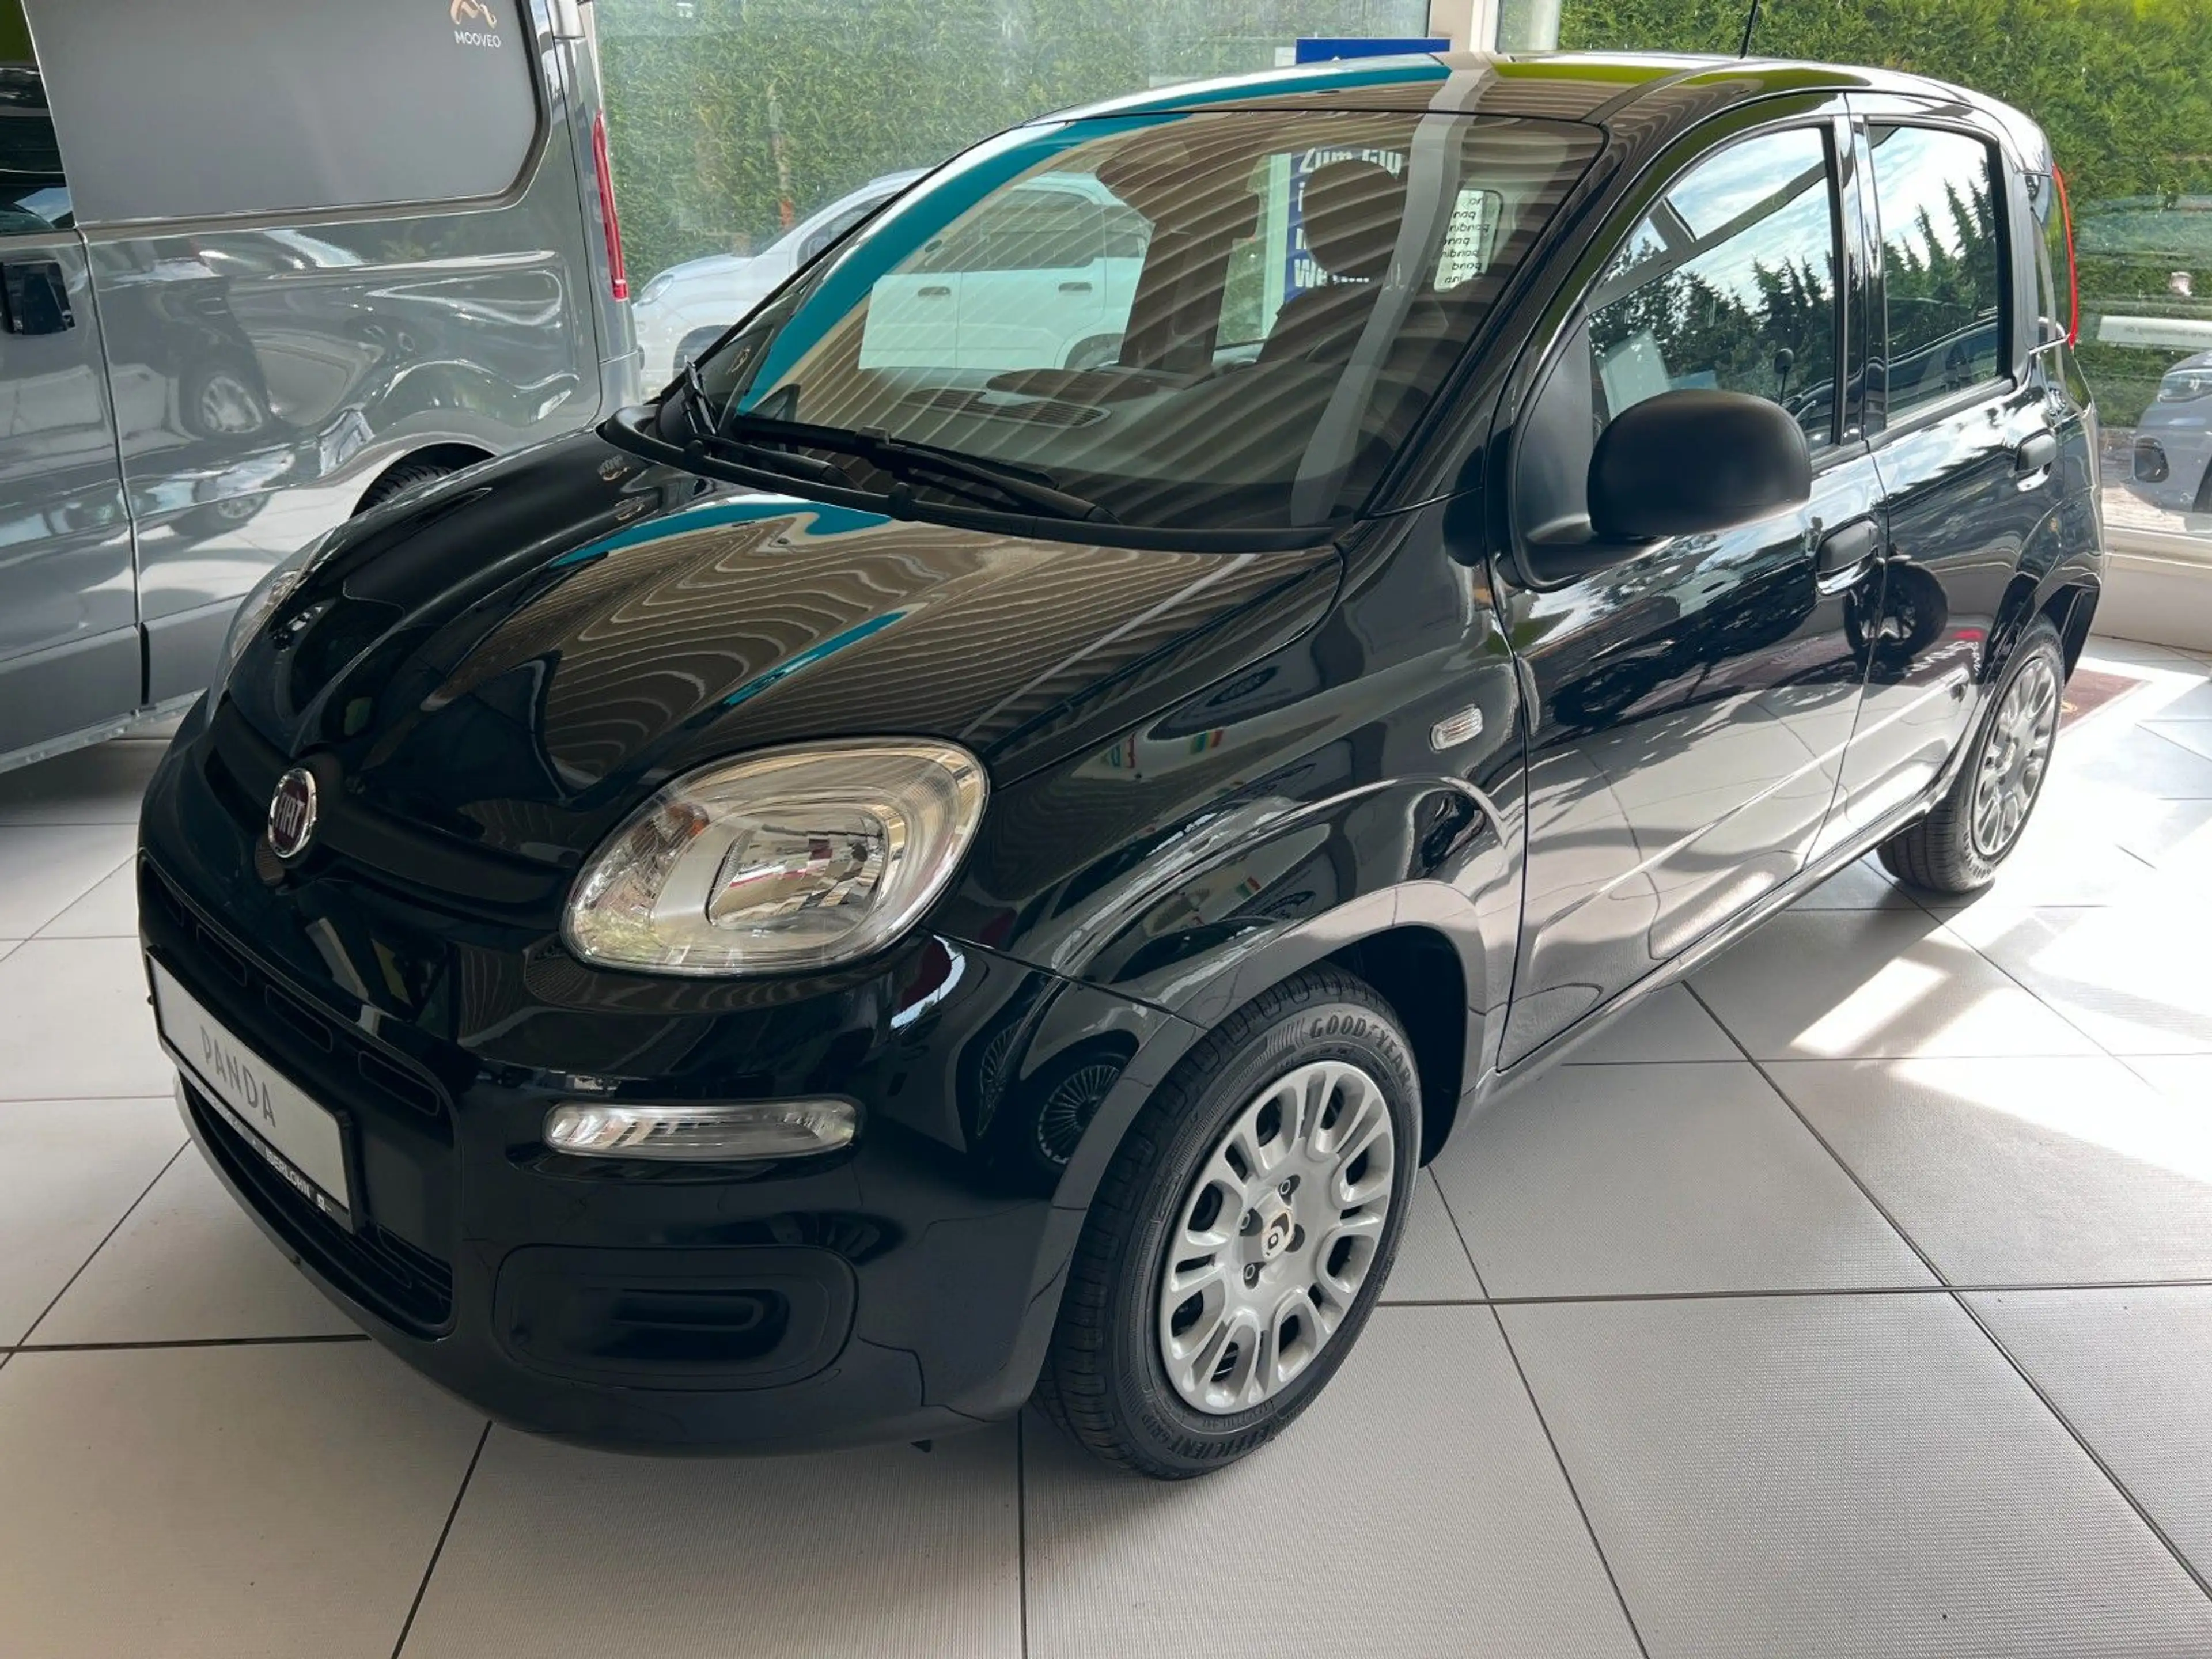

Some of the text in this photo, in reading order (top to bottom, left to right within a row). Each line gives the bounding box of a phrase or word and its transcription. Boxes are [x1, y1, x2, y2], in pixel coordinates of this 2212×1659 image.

[454, 30, 501, 48] MOOVEO
[275, 791, 306, 839] FIAT
[200, 1024, 276, 1128] PANDA
[1309, 1015, 1411, 1088] GOODYEAR
